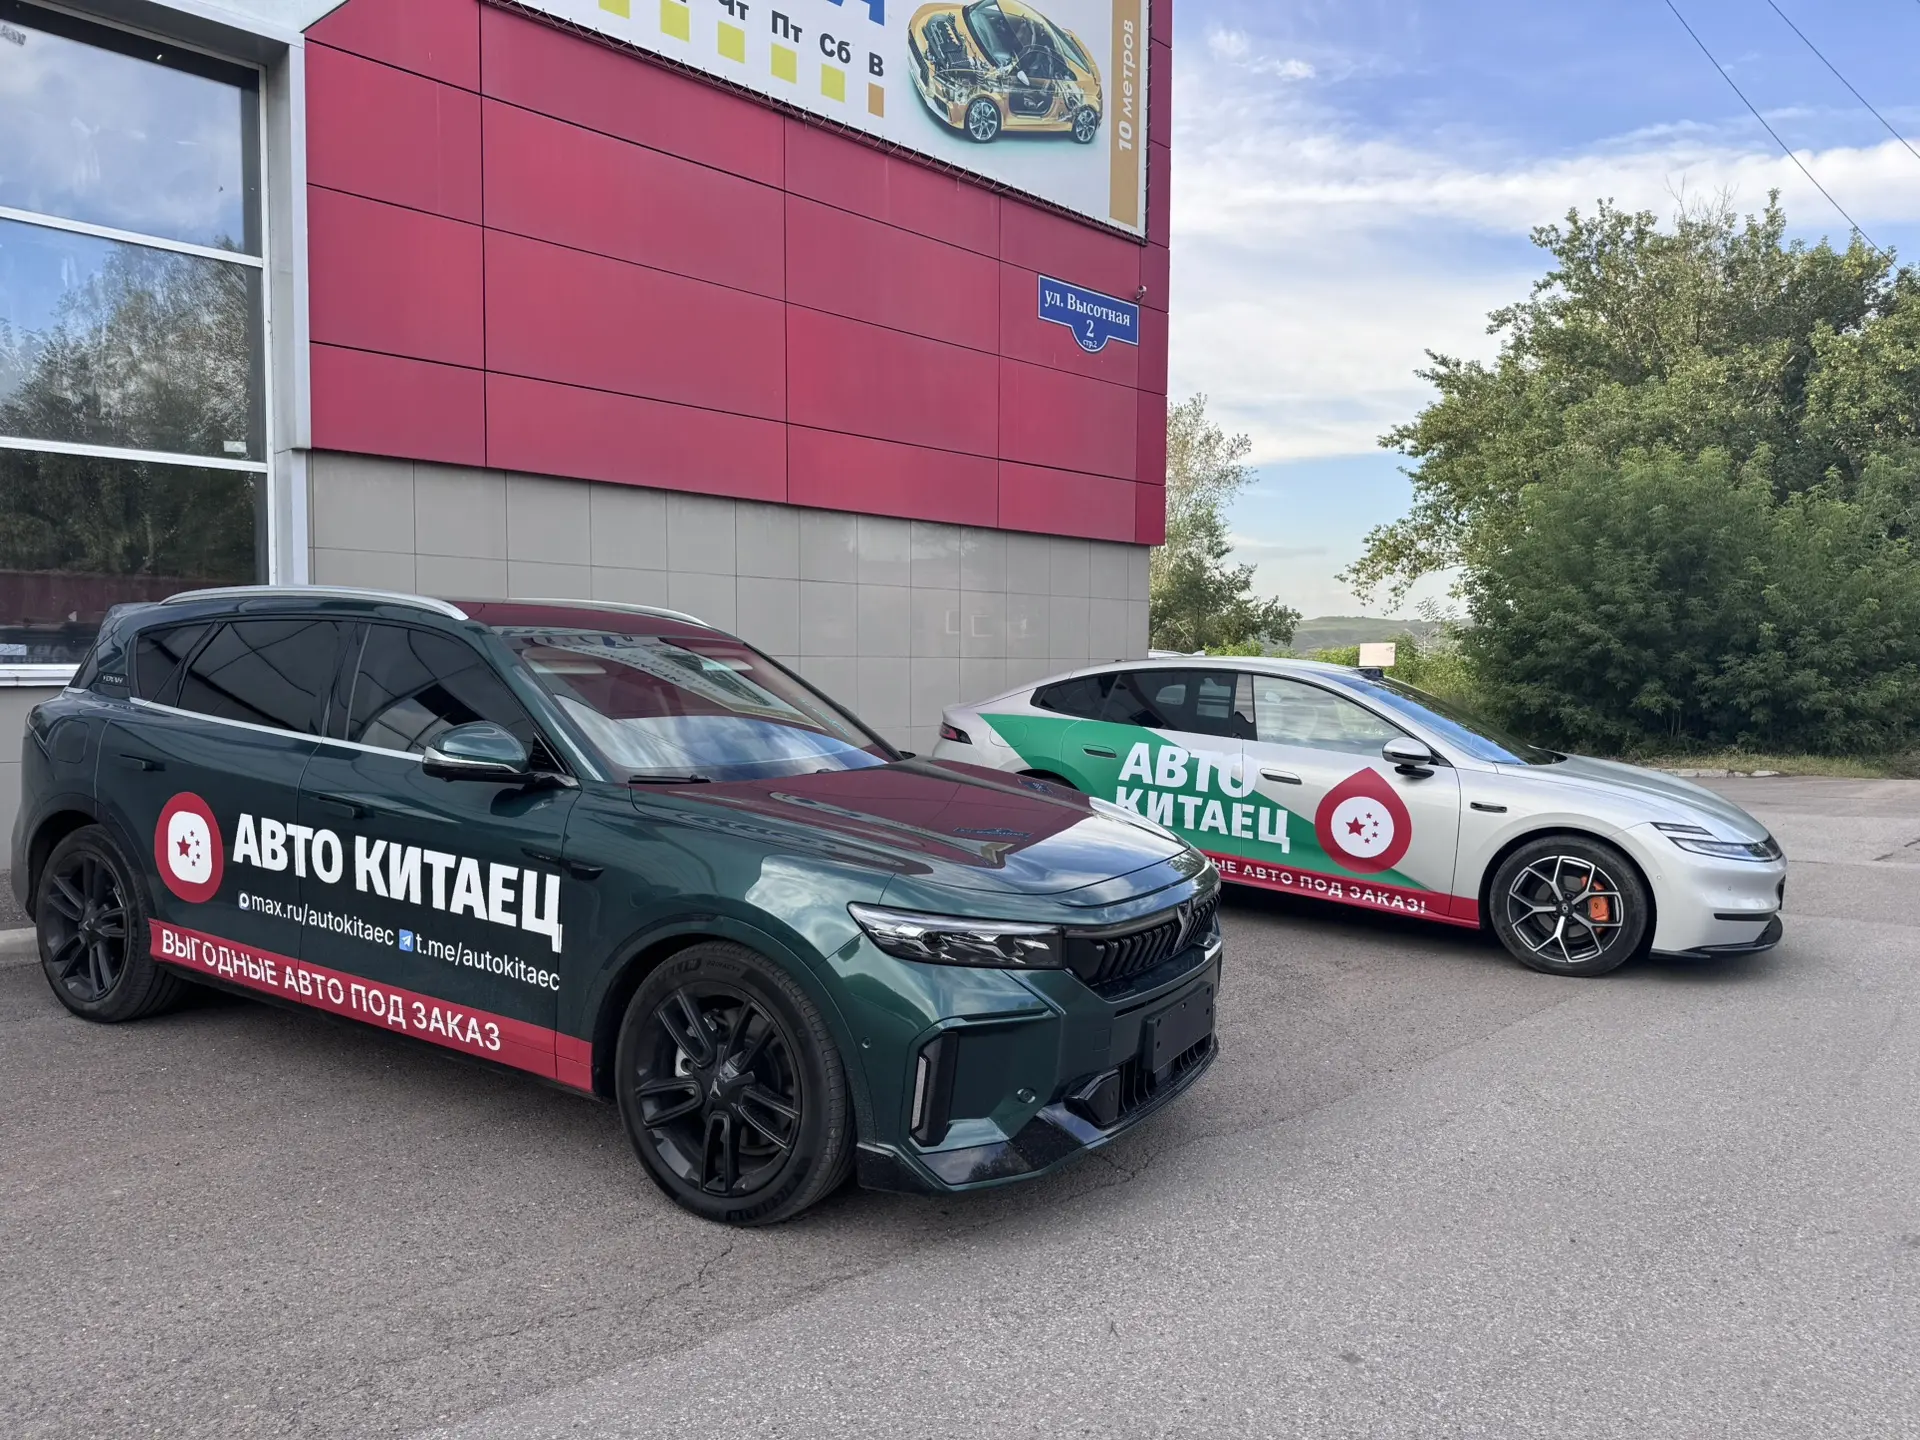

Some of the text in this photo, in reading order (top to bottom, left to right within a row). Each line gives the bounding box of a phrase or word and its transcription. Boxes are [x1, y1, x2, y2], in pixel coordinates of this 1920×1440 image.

[771, 10, 803, 43] Пт
[819, 33, 851, 64] Сб
[1119, 19, 1136, 151] 10 метров
[1044, 290, 1131, 326] ул. Высотная
[1086, 320, 1095, 338] 2
[1118, 742, 1260, 798] АВТО
[1115, 786, 1291, 854] КИТАЕЦ
[232, 812, 563, 954] АВТО КИТАЕЦ
[1243, 864, 1293, 885] АВТО
[1300, 876, 1342, 897] ПОД
[1350, 886, 1426, 914] ЗАКАЗ!
[251, 893, 395, 946] max.ru/autokitaec
[161, 929, 501, 1052] ВЫГОДНЫЕ АВТО ПОД ЗАКАЗ
[416, 934, 561, 991] t.me/autokitaec
